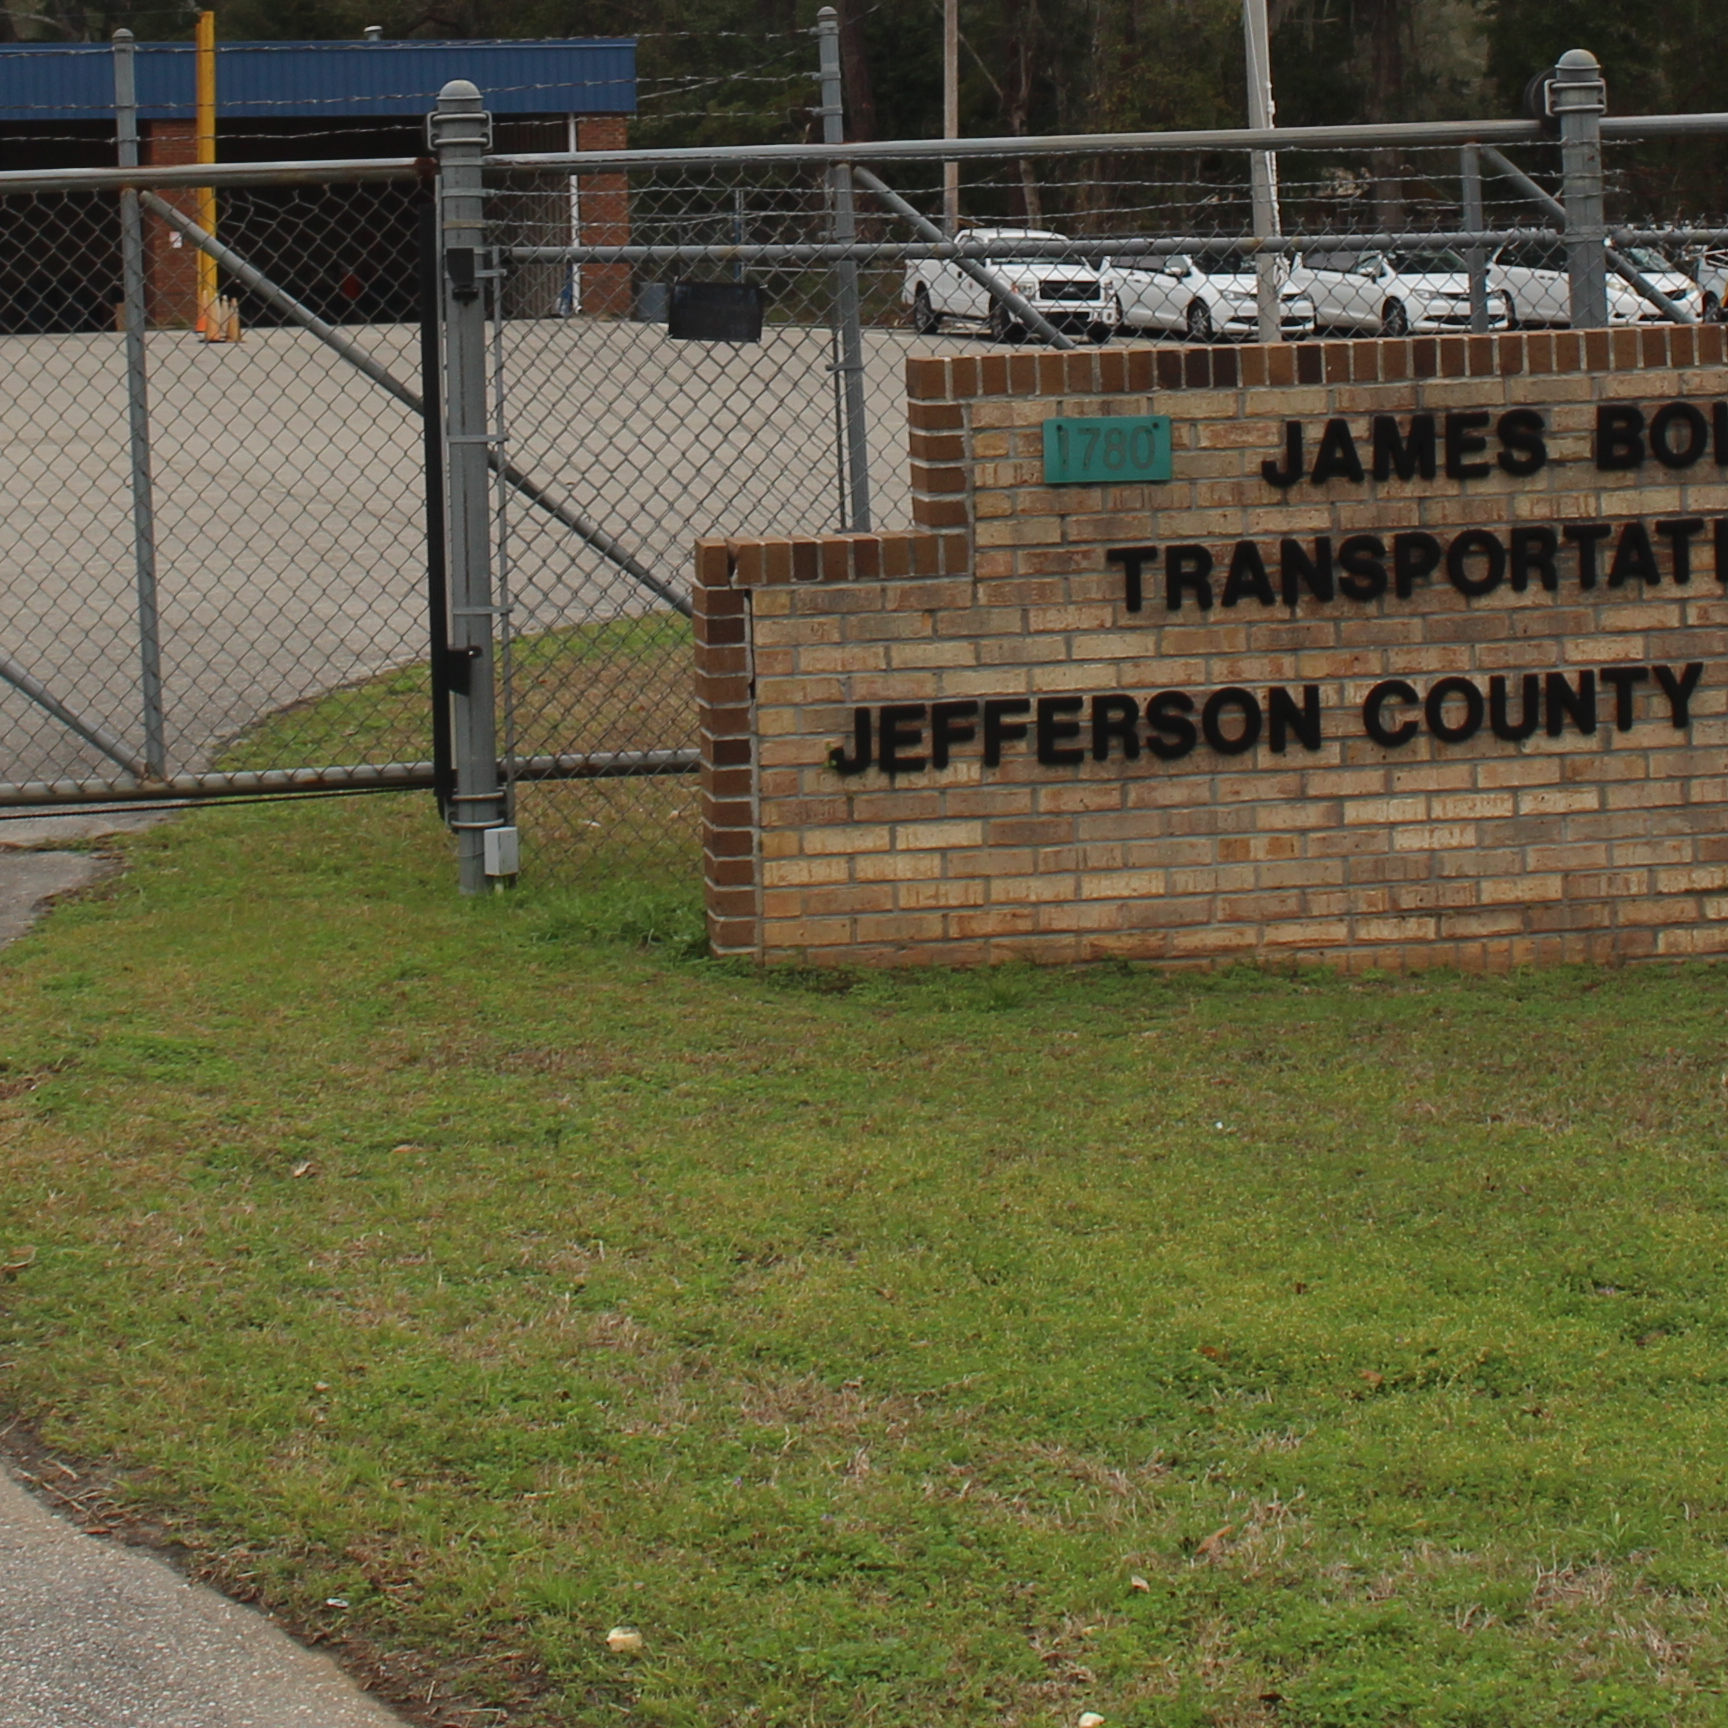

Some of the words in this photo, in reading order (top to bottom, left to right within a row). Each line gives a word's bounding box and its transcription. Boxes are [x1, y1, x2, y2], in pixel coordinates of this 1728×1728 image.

[1057, 424, 1156, 472] 1780
[1261, 409, 1547, 490] JAMES
[828, 685, 1323, 775] JEFFERSON
[1362, 662, 1704, 749] COUNTY
